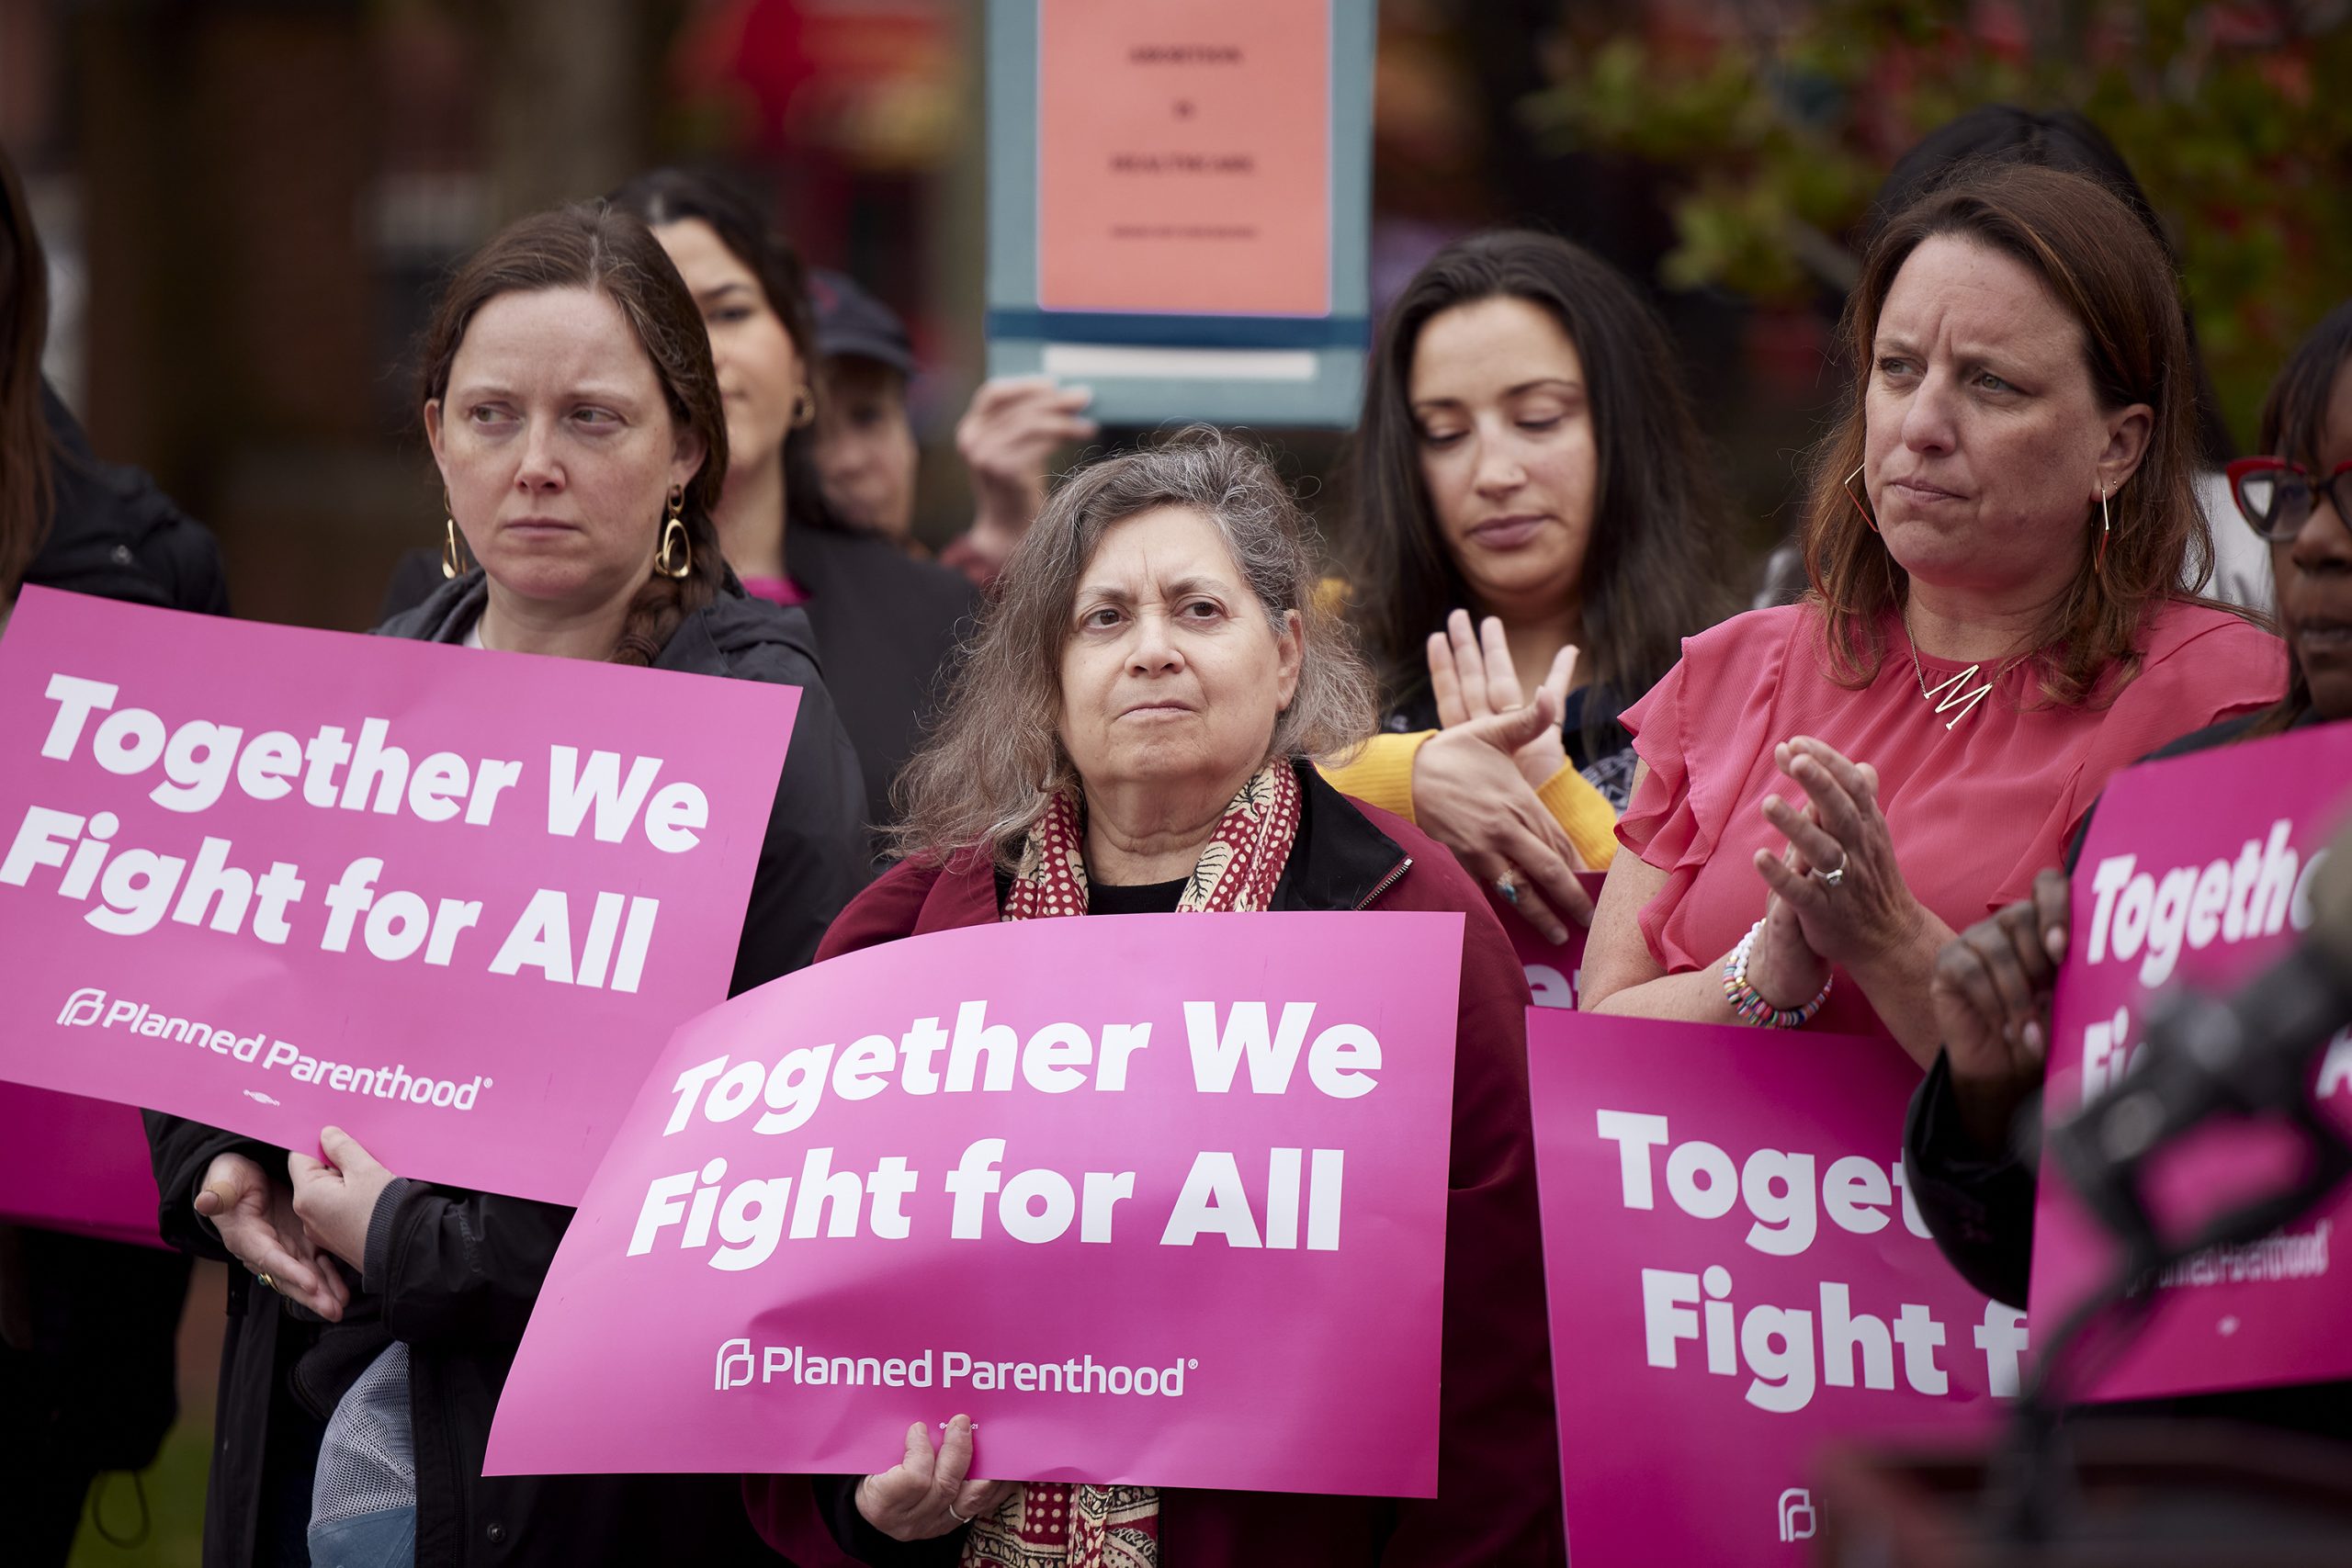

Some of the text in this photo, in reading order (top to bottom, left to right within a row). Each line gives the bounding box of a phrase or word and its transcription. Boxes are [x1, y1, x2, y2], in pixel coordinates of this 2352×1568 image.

[41, 673, 709, 853] Together We
[0, 806, 660, 994] Fight for All
[2086, 818, 2331, 989] Togeth
[102, 999, 266, 1063] Planned
[662, 999, 1383, 1137] Together We
[626, 1137, 1344, 1271] Fight for All
[762, 1346, 933, 1388] Planned
[1641, 1265, 1949, 1413] Fight
